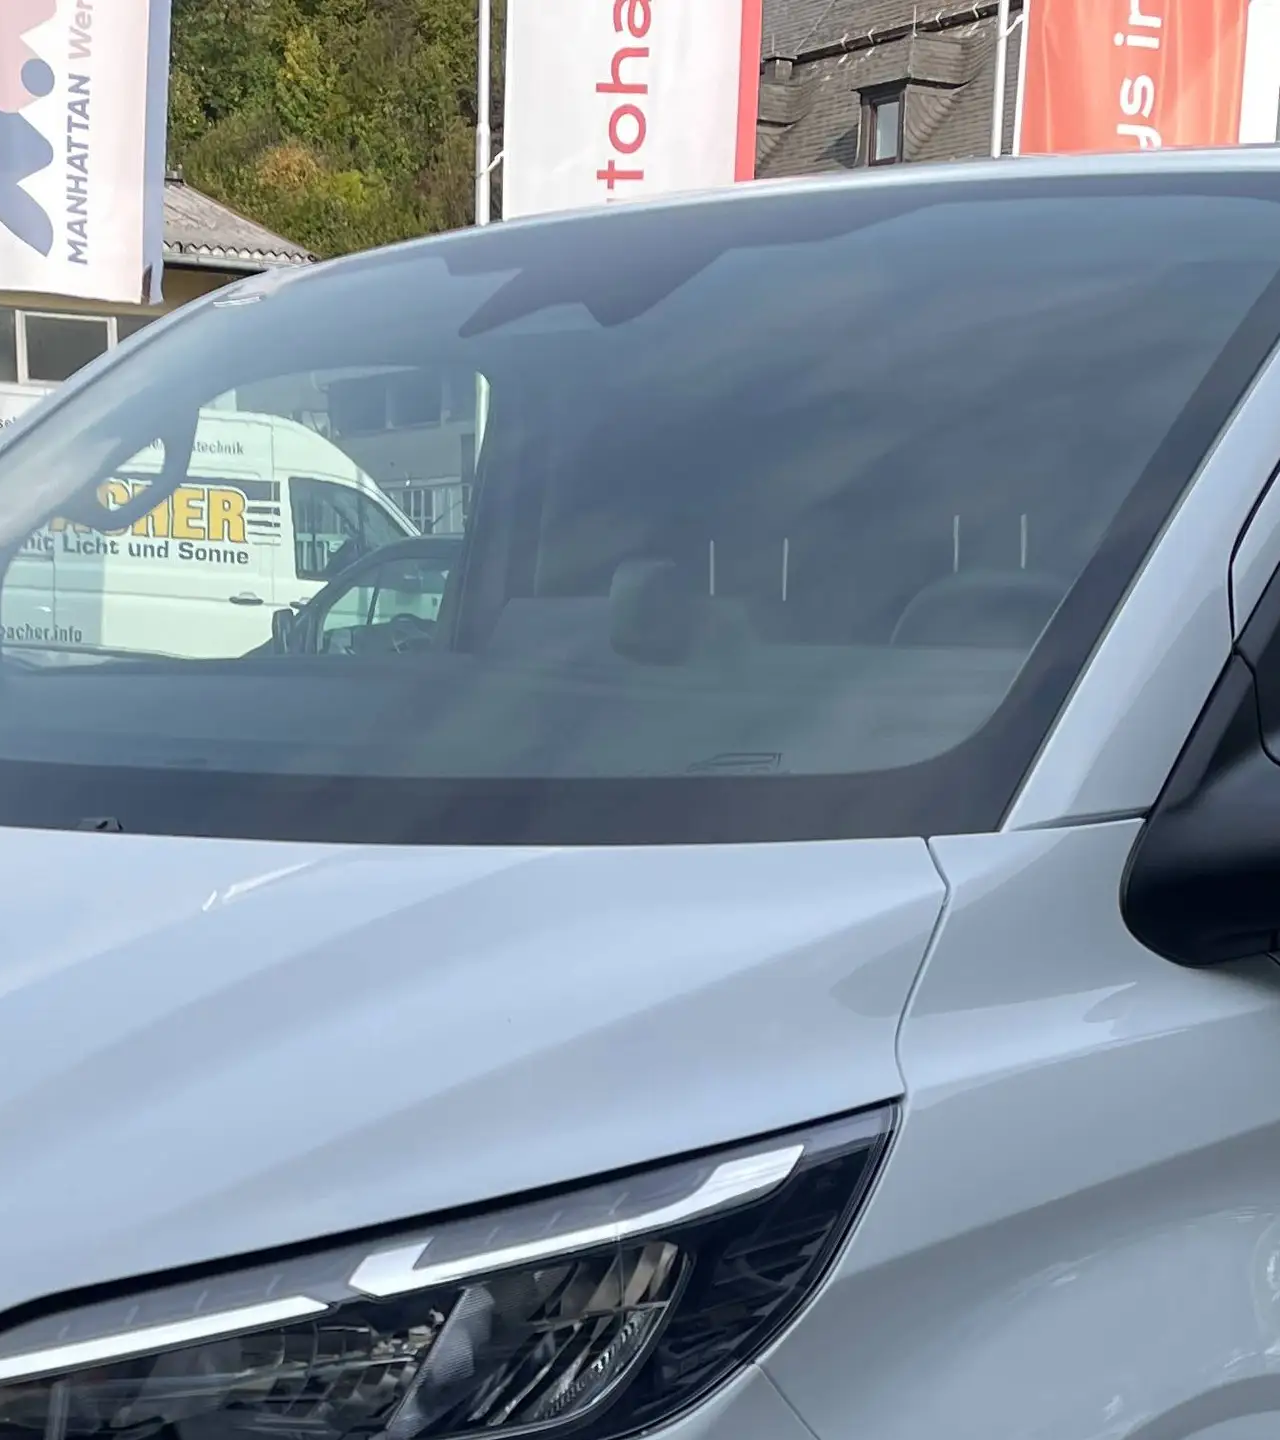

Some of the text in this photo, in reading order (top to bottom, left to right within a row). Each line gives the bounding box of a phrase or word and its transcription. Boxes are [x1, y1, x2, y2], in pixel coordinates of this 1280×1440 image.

[66, 73, 91, 265] MANHATTAN
[596, 0, 652, 203] toha
[63, 534, 120, 556] Licht
[128, 540, 169, 558] und
[177, 541, 250, 565] Sonne
